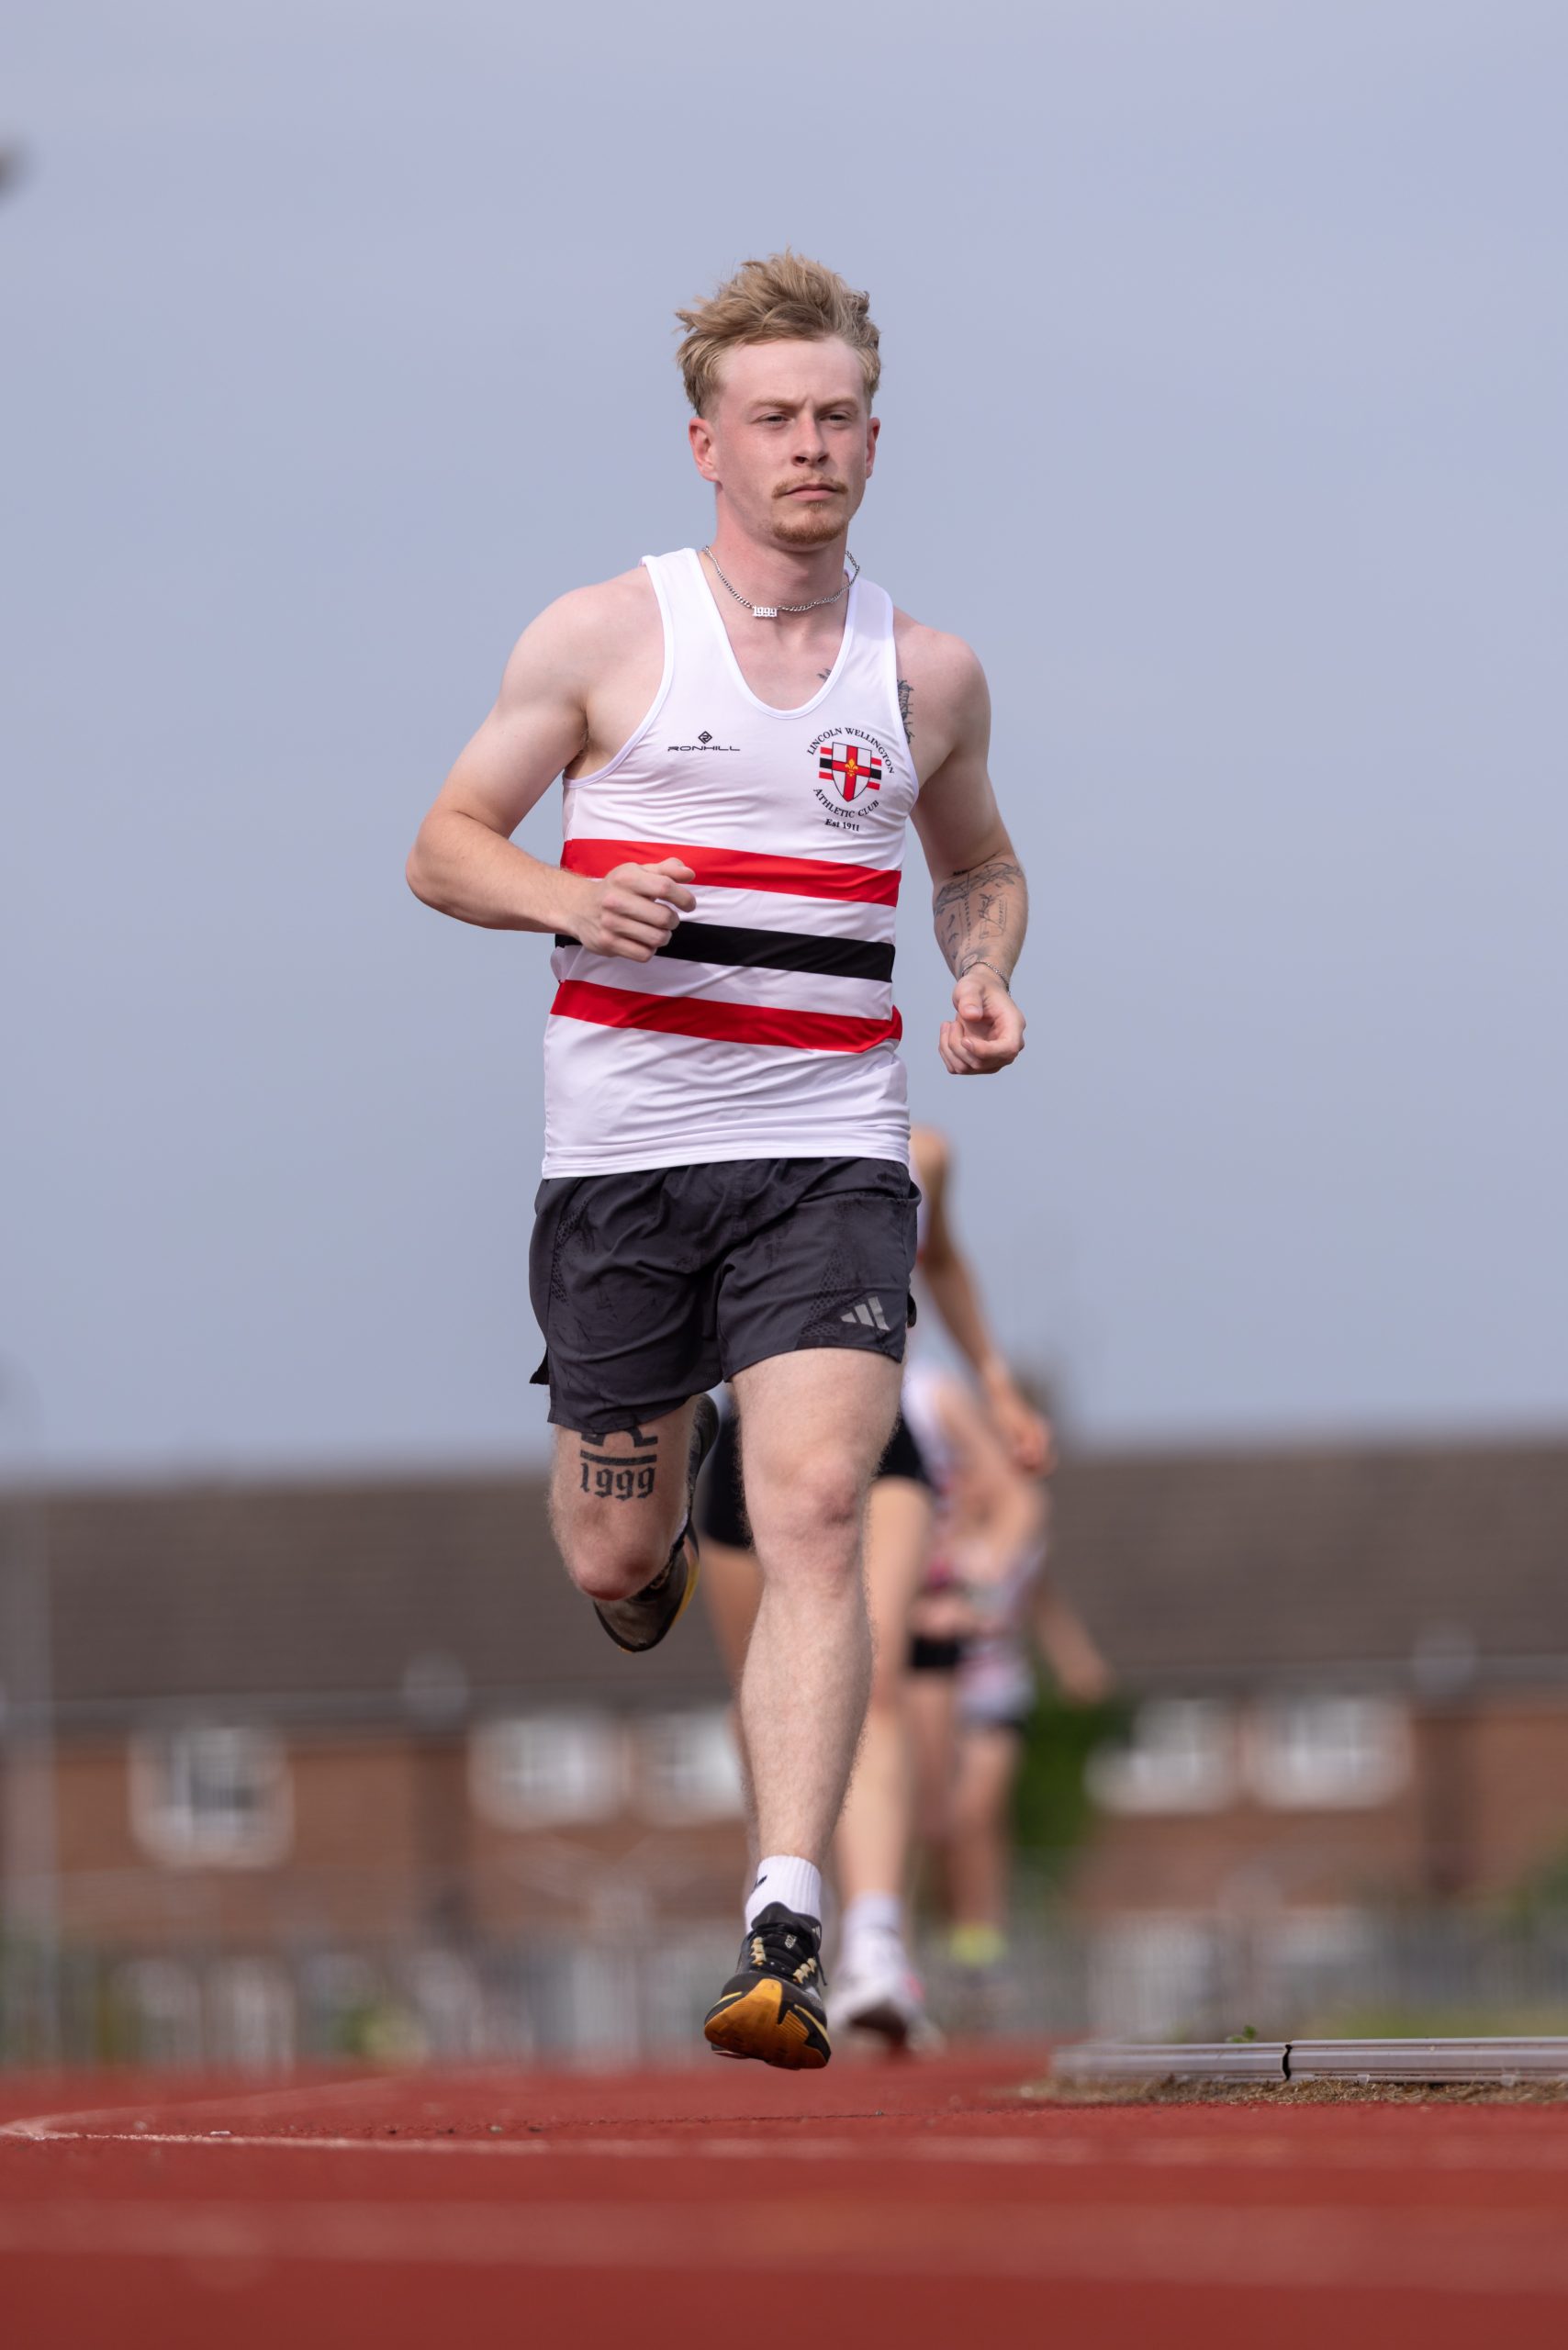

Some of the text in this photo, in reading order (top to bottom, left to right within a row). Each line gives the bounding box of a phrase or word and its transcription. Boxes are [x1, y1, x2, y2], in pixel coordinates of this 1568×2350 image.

[752, 605, 778, 617] 1999
[807, 727, 895, 774] LINCOLN WELLINGTON
[813, 788, 879, 818] ATHLETIC CLUB
[824, 818, 860, 832] Est 1911
[580, 1462, 656, 1501] 1999
